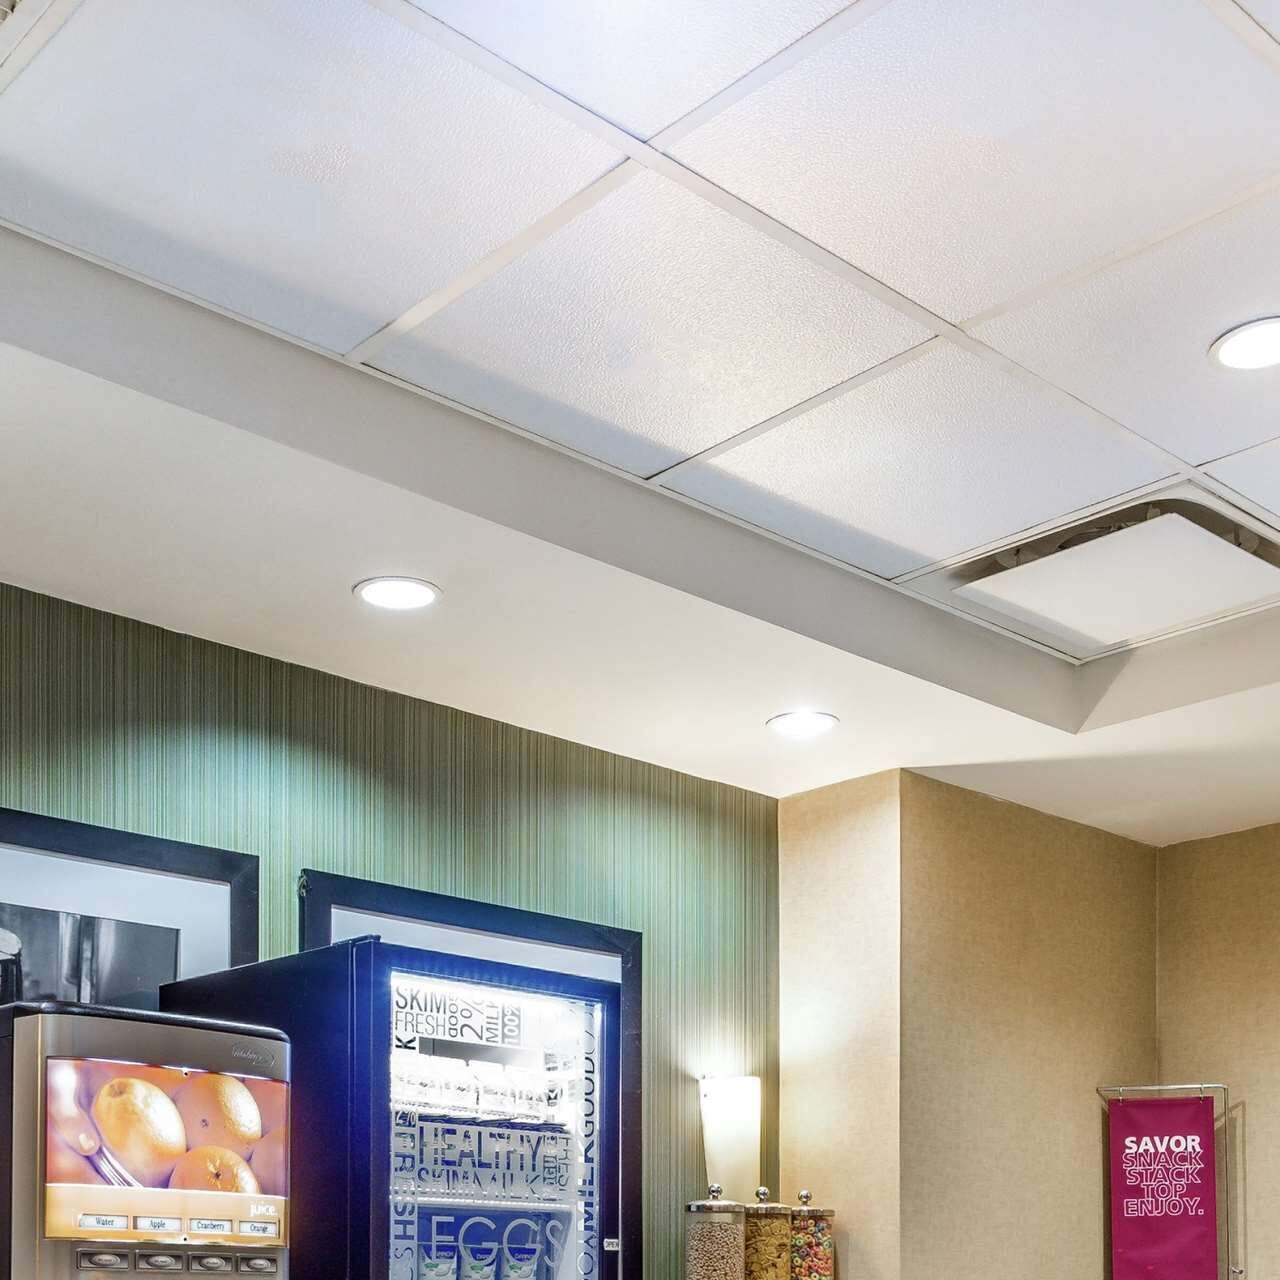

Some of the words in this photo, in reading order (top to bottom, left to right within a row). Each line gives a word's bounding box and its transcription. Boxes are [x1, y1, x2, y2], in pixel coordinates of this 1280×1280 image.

[395, 986, 447, 1015] SKIM
[395, 1010, 446, 1038] FRESH
[578, 1056, 595, 1138] GOOD
[417, 1126, 543, 1172] HEALTHY
[1124, 1135, 1202, 1154] SAVOR
[1122, 1151, 1204, 1169] SNACK
[1125, 1167, 1202, 1184] STACK
[1141, 1183, 1187, 1199] TOP
[1123, 1197, 1205, 1216] ENJOY.
[95, 1216, 114, 1227] Water
[149, 1220, 166, 1229] Apple
[197, 1221, 225, 1231] Cranberry
[250, 1223, 268, 1234] Orange
[432, 1214, 564, 1268] EGGS
